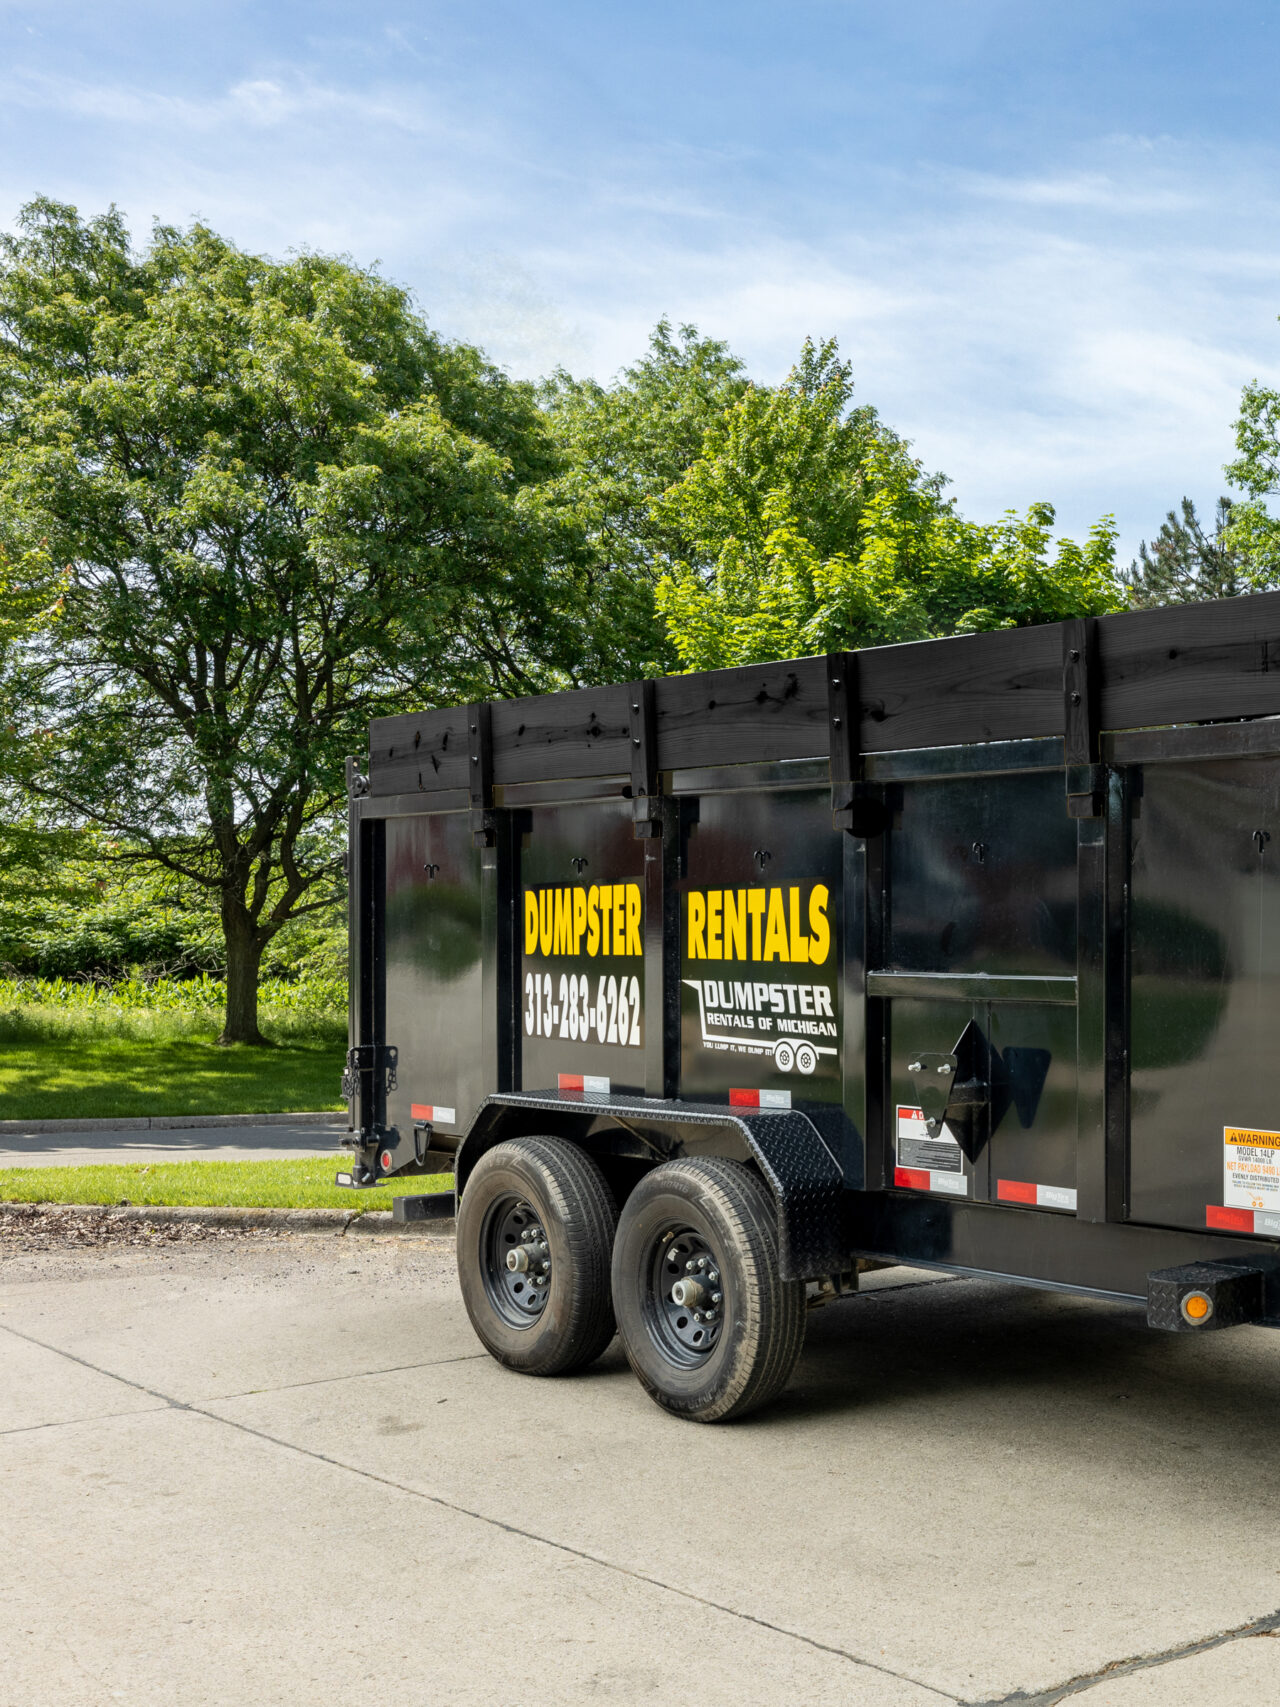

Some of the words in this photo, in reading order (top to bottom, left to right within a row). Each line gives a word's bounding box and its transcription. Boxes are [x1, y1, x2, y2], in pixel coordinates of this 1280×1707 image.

[524, 883, 643, 957] DUMPSTER
[687, 884, 831, 965] RENTALS
[703, 980, 835, 1017] DUMPSTER
[524, 972, 641, 1046] 313-283-6262
[706, 1012, 755, 1029] RENTALS
[758, 1016, 773, 1030] OF
[776, 1018, 838, 1037] MICHIGAN
[703, 1041, 714, 1049] YOU
[1237, 1146, 1258, 1157] MODEL
[1260, 1149, 1275, 1158] 14LP
[1226, 1161, 1237, 1171] NET
[1237, 1162, 1262, 1174] PAYLOAD
[1232, 1172, 1249, 1180] EVENLY
[1249, 1174, 1280, 1184] DISTRIBUTED
